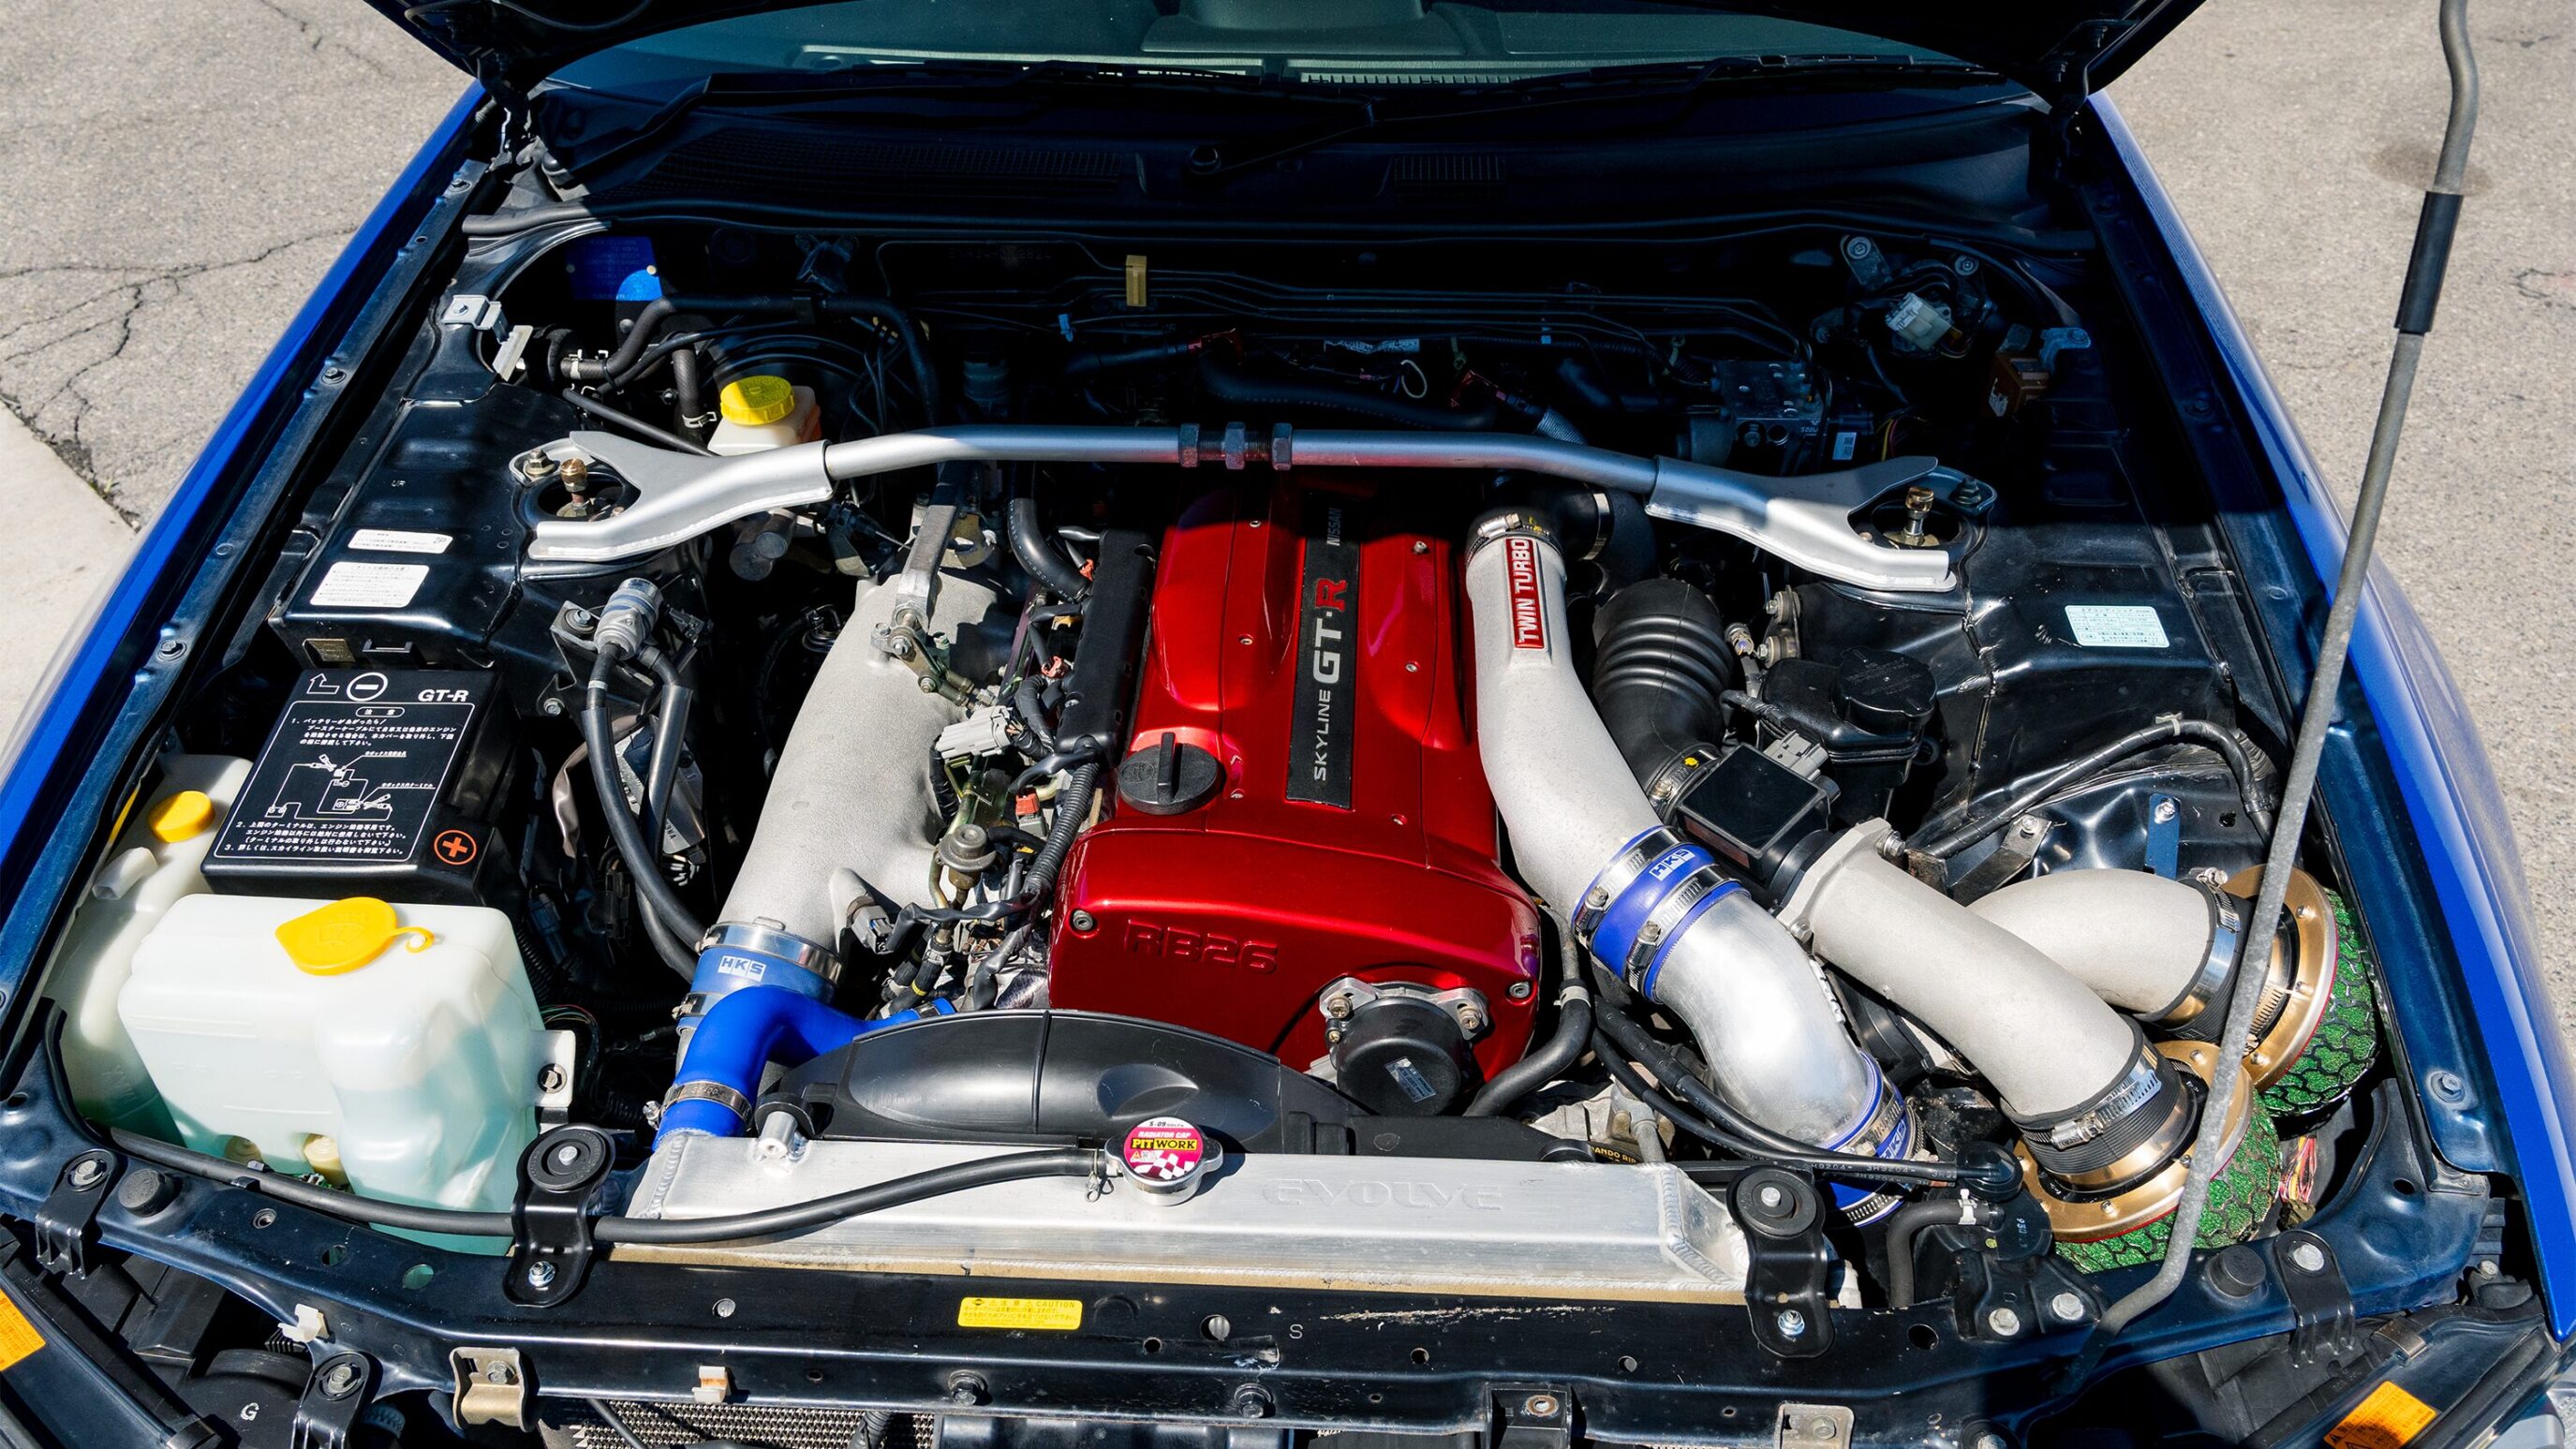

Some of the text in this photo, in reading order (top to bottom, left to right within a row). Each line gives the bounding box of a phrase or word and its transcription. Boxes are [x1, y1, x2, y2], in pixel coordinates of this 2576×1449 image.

[1325, 508, 1341, 547] NISSAN
[1510, 540, 1539, 643] TWIN TURBO
[418, 689, 469, 702] GT-R
[1313, 689, 1331, 781] SKYLINE
[1651, 850, 1690, 876] HKS
[1124, 919, 1280, 975] RB26
[722, 957, 764, 975] HKS
[1591, 1146, 1621, 1159] ANDO
[1262, 1178, 1502, 1211] EVOLVE
[1289, 1323, 1303, 1339] S
[240, 1402, 259, 1421] G
